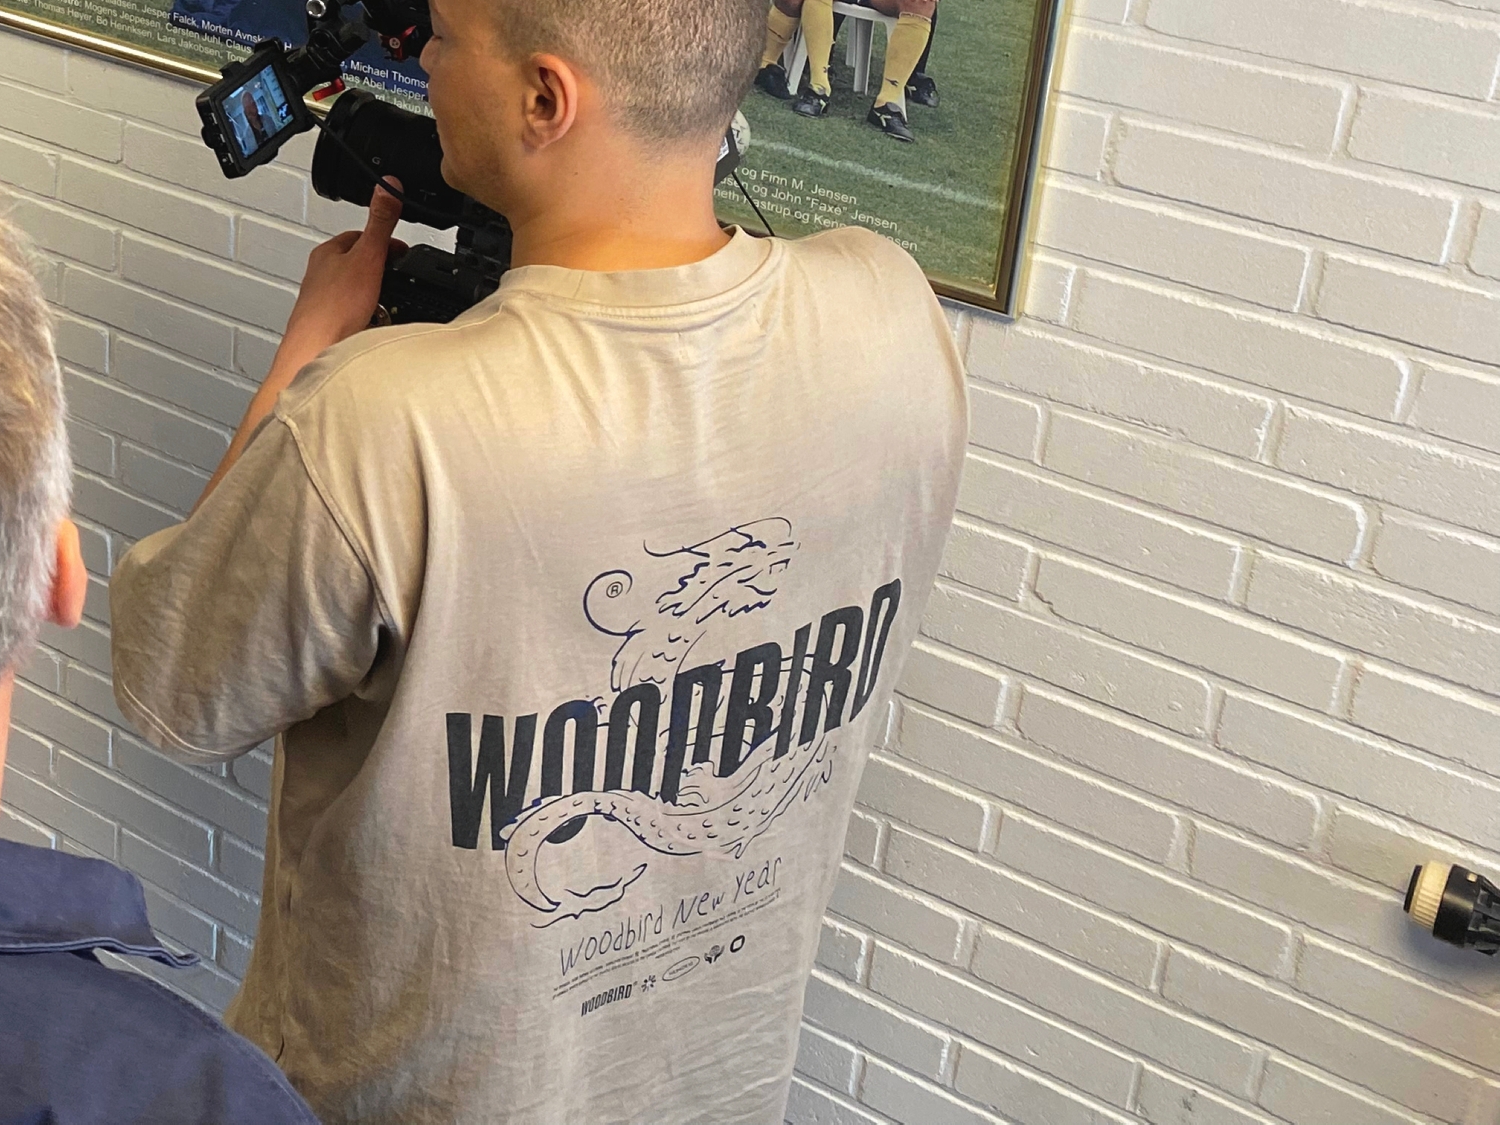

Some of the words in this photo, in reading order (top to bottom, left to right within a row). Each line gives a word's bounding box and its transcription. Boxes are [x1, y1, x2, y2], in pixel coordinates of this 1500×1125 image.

[84, 0, 118, 18] Mogens
[165, 22, 200, 40] Carsten
[202, 32, 223, 47] Juhl,
[225, 38, 252, 54] Claus
[390, 84, 426, 101] Jesper
[753, 184, 768, 197] og
[772, 188, 802, 205] John
[806, 196, 848, 216] "Faxe"
[96, 15, 108, 26] Bo
[157, 32, 176, 45] Lars
[794, 210, 810, 224] og
[141, 4, 172, 21] Jesper
[173, 11, 199, 29] Falck,
[202, 20, 233, 37] Morten
[350, 60, 389, 79] Michael
[741, 167, 757, 180] og
[761, 170, 788, 187] Finn
[445, 578, 901, 851] WOODBIRD
[580, 983, 633, 1017] WOODBIRD
[672, 891, 726, 930] New
